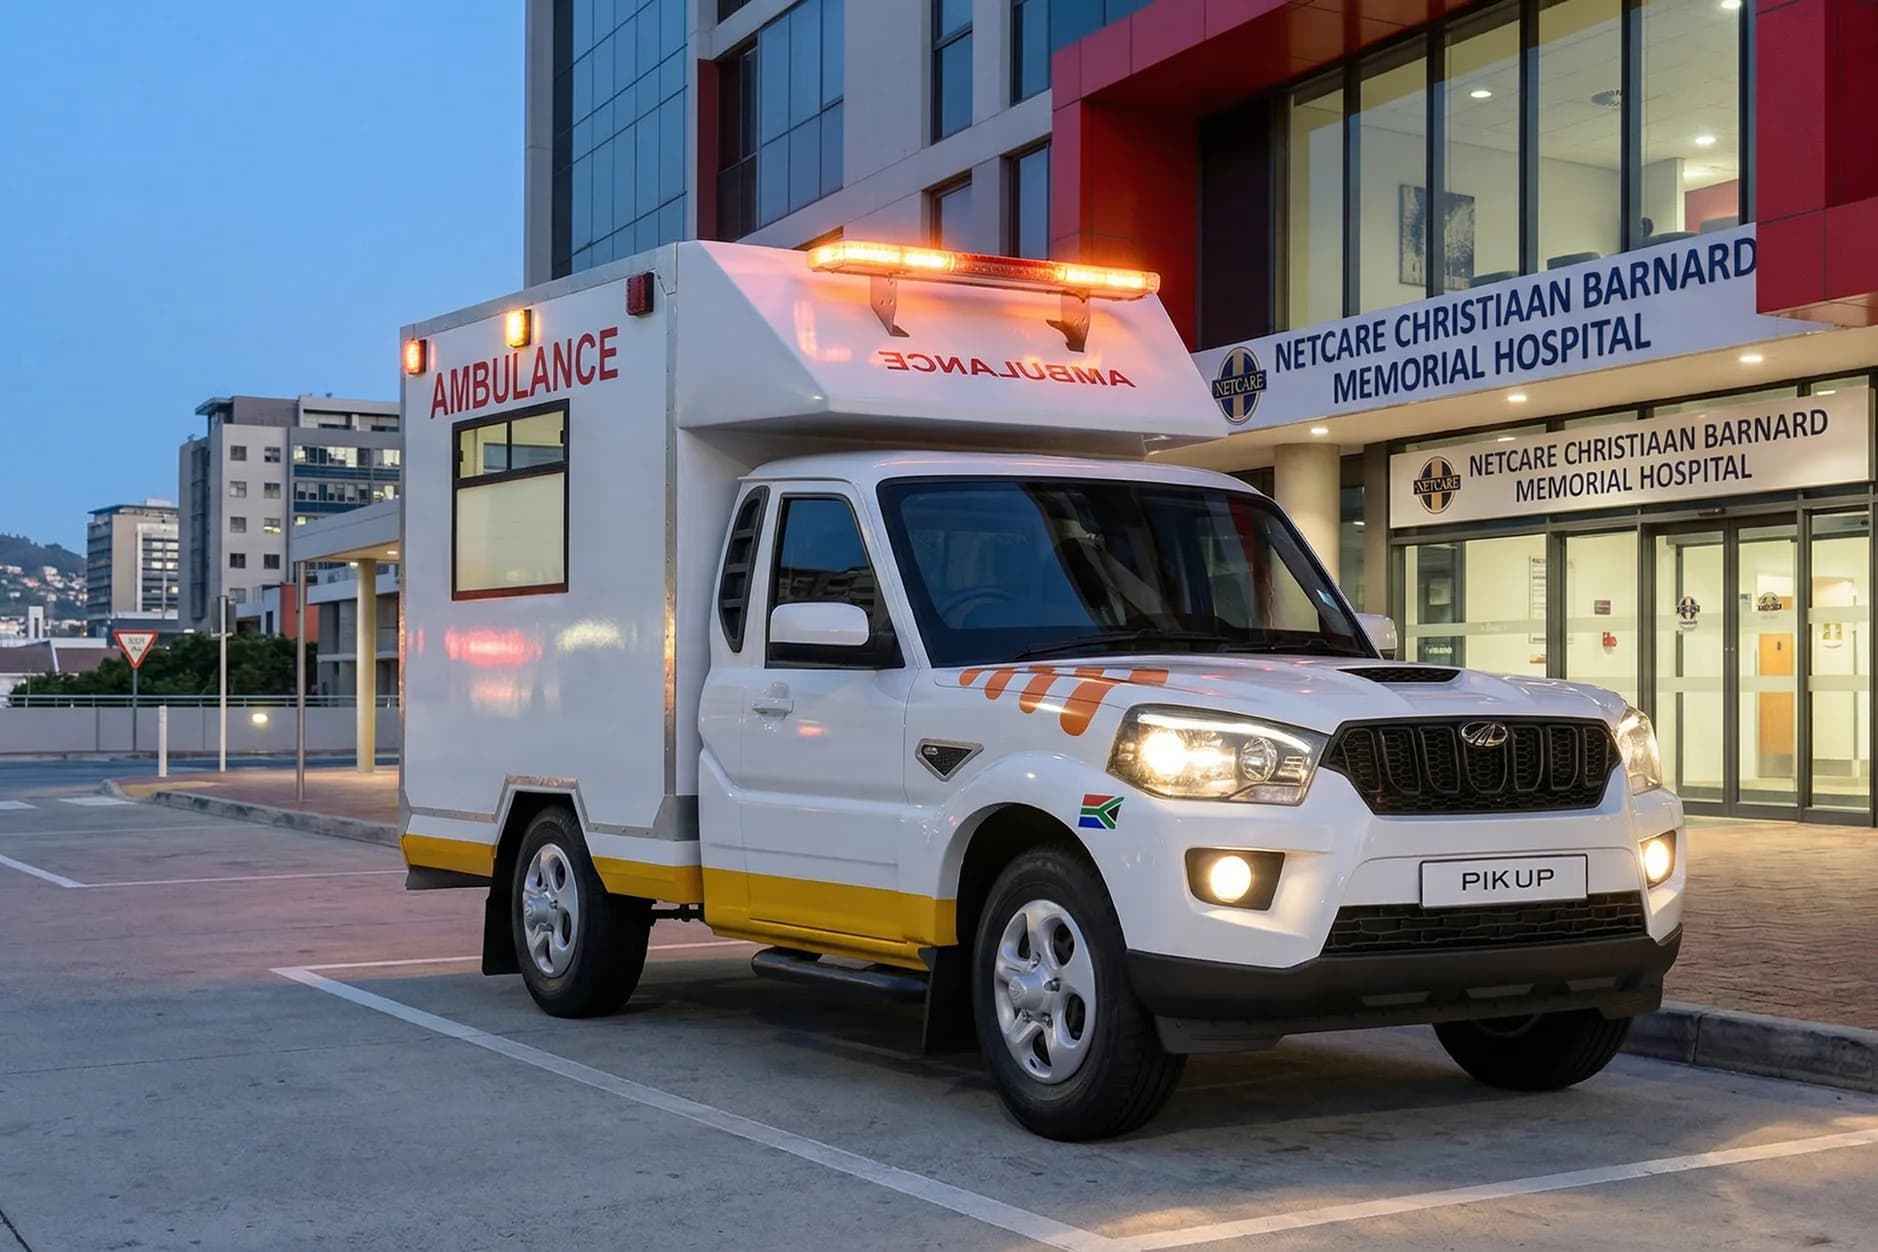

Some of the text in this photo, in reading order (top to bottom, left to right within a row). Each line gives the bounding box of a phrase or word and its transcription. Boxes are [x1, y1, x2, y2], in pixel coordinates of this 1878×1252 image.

[1276, 237, 1757, 373] NETCARE CHRISTIAAN BARNARD
[430, 326, 618, 419] AMBULANCE
[1215, 374, 1264, 397] NETCARE
[1333, 313, 1652, 404] MEMORIAL HOSPITAL
[1470, 409, 1828, 477] NETCARE CHRISTIAAN BARNARD
[1415, 477, 1460, 494] NETCARE
[1516, 453, 1752, 502] MEMORIAL HOSPITAL
[1461, 868, 1555, 891] PIKUP
